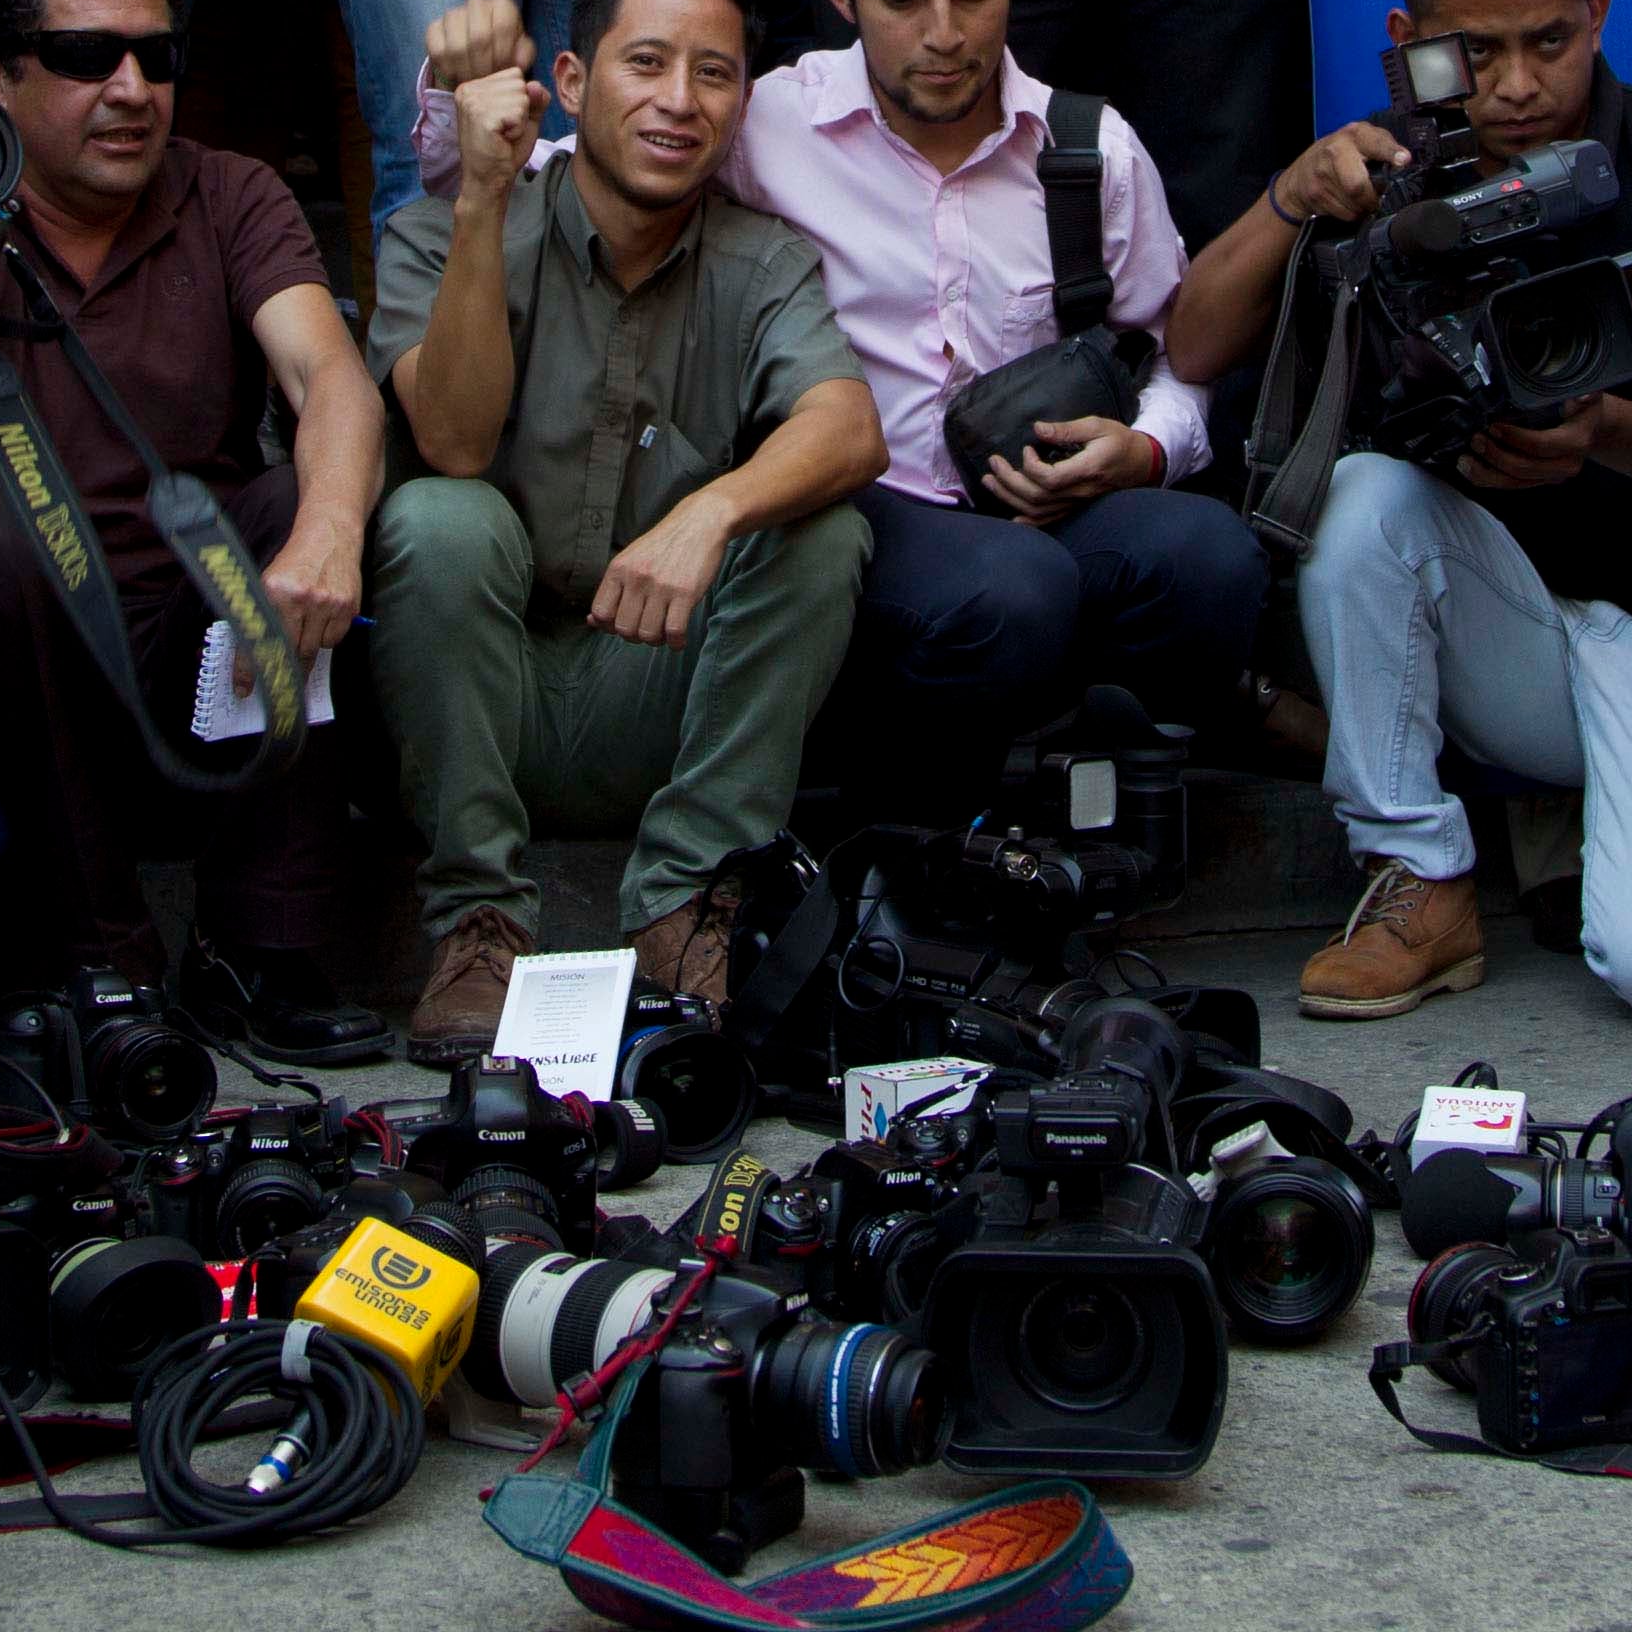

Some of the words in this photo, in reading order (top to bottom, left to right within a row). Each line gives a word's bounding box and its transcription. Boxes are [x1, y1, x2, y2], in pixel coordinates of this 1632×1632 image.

[1453, 191, 1484, 206] SONY
[95, 992, 132, 1004] Canon
[639, 999, 671, 1011] Nikon
[529, 1055, 559, 1066] ENSA
[562, 1052, 598, 1065] LIBRE
[1436, 1097, 1516, 1108] ANTIGUA
[477, 1128, 526, 1141] Canon
[1046, 1132, 1107, 1144] Panasonic
[250, 1137, 288, 1148] Nikon
[885, 1171, 920, 1184] Nikon
[72, 1199, 113, 1211] Canon
[335, 1267, 432, 1322] emisoras
[354, 1289, 425, 1331] unidas
